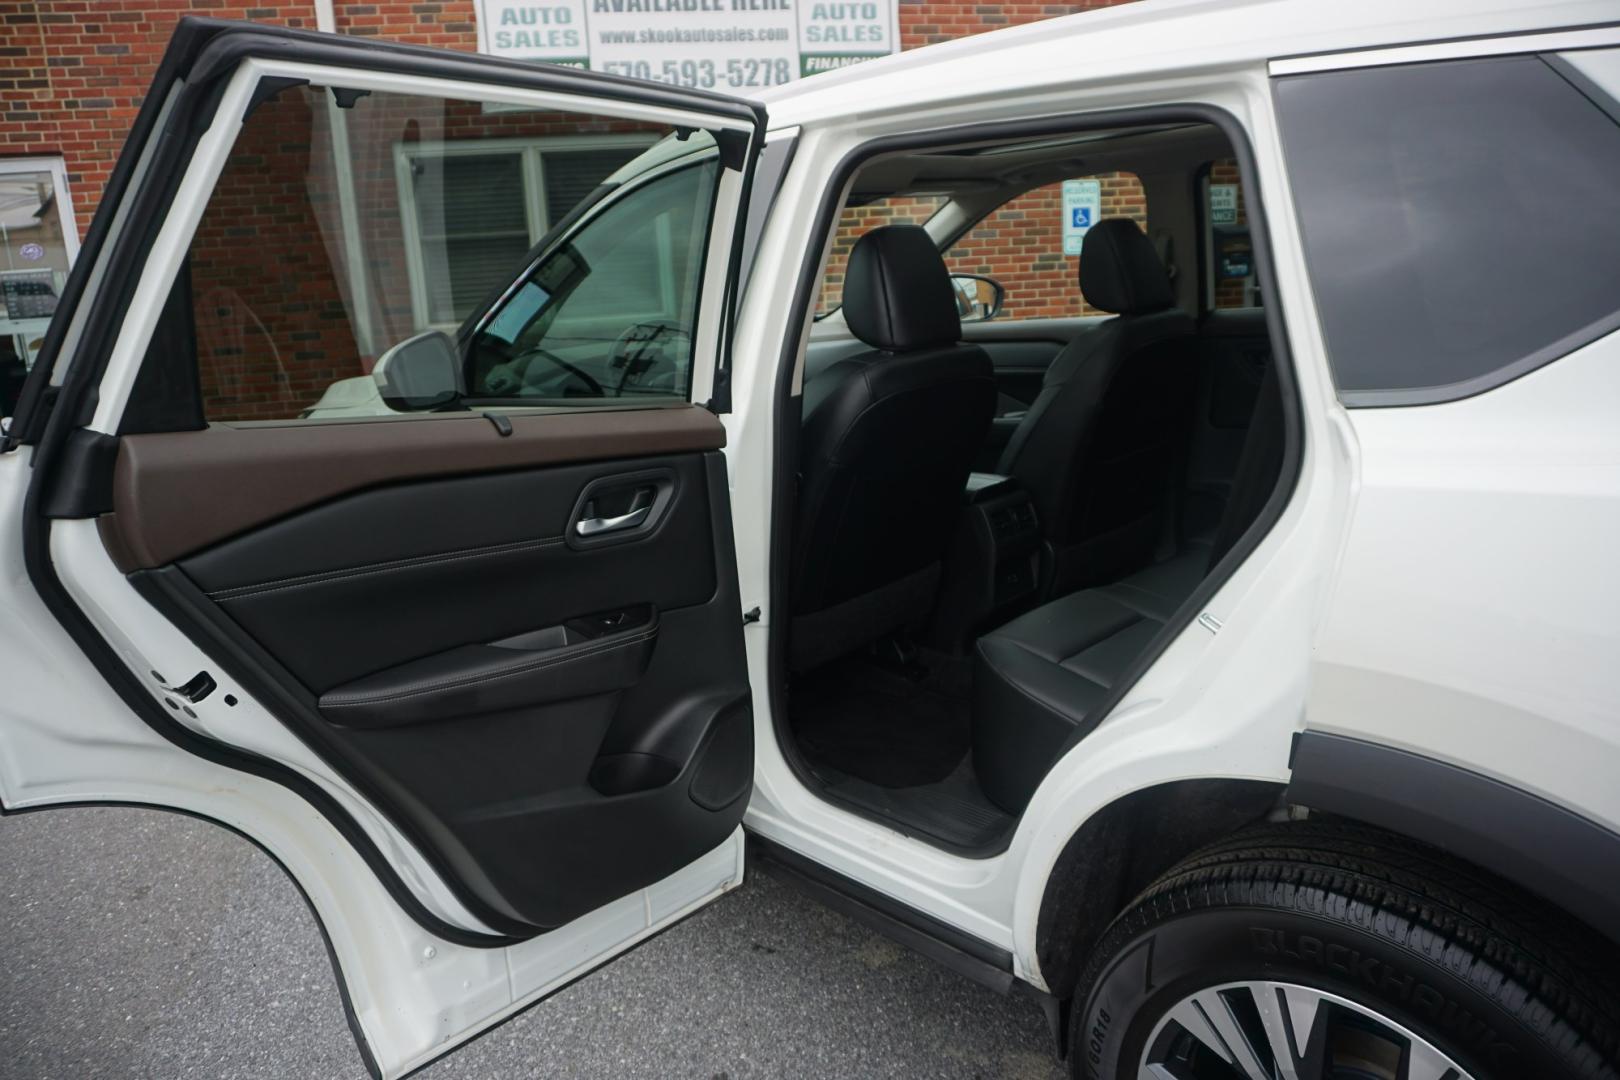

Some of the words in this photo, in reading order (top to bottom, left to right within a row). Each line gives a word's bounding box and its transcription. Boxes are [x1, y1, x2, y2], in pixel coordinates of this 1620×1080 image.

[501, 6, 572, 25] AUTO
[811, 3, 877, 20] AUTO
[495, 30, 580, 48] SALES
[599, 27, 789, 44] www.skookautosales.com
[806, 25, 883, 42] SALES
[1249, 926, 1519, 1066] BLACKHAWK
[1087, 1007, 1112, 1080] /60R18
